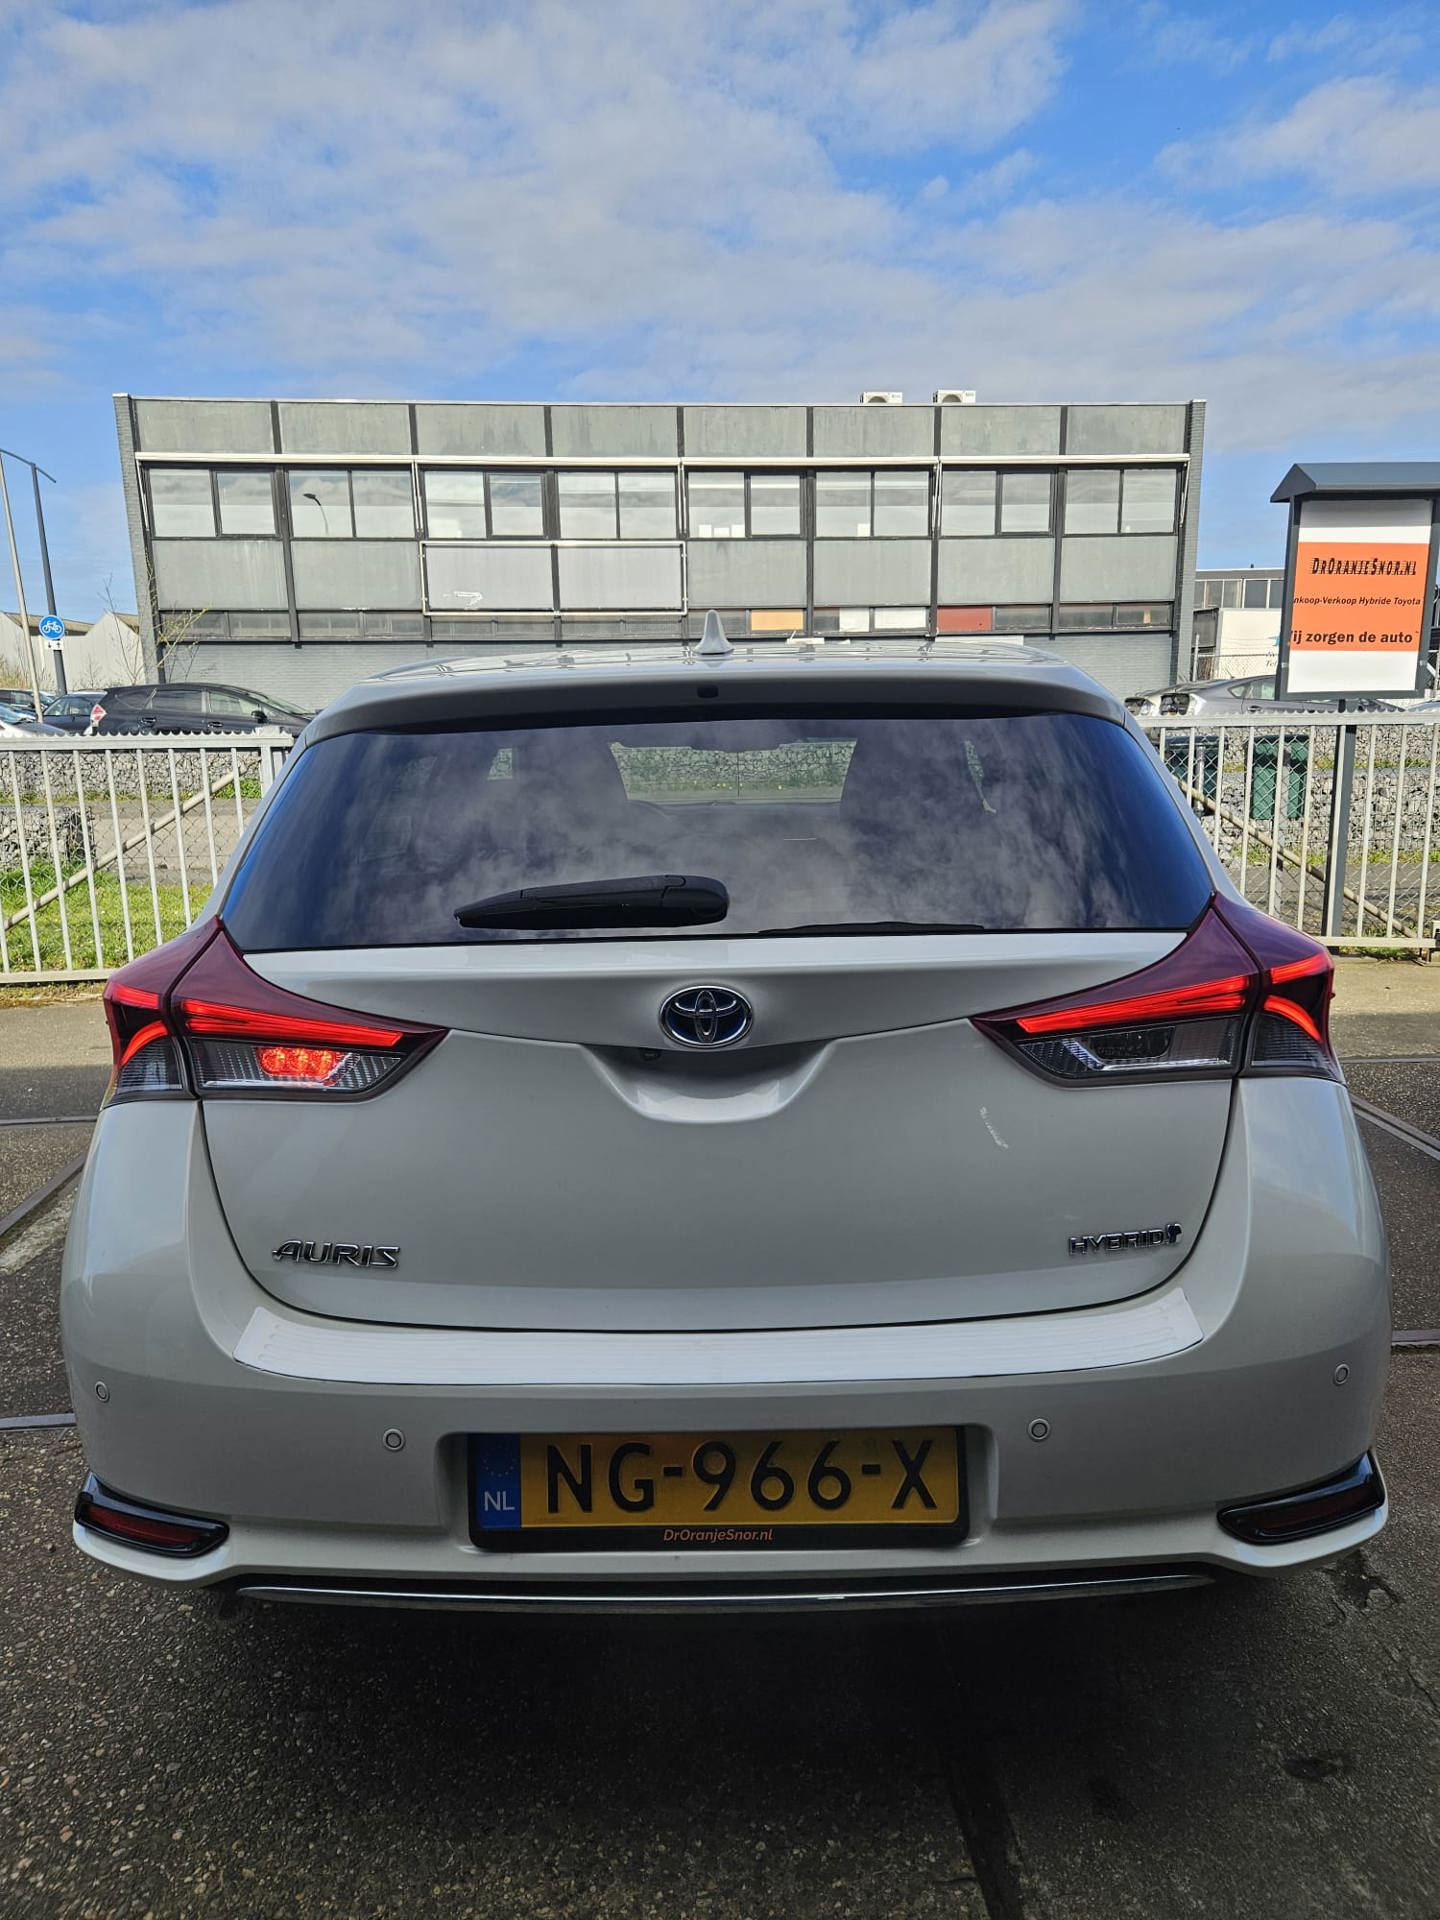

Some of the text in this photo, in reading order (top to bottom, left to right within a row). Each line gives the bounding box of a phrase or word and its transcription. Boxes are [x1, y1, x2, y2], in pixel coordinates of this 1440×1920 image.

[1359, 596, 1392, 607] Hybride
[1394, 597, 1421, 607] Toyota
[1291, 630, 1413, 645] ij zorgen de auto
[1069, 1229, 1164, 1254] HYBRID
[272, 1240, 400, 1268] AURIS
[546, 1439, 939, 1514] NG-966-X
[483, 1490, 516, 1512] NL
[663, 1528, 774, 1543] DrOranjeSnor.nl
